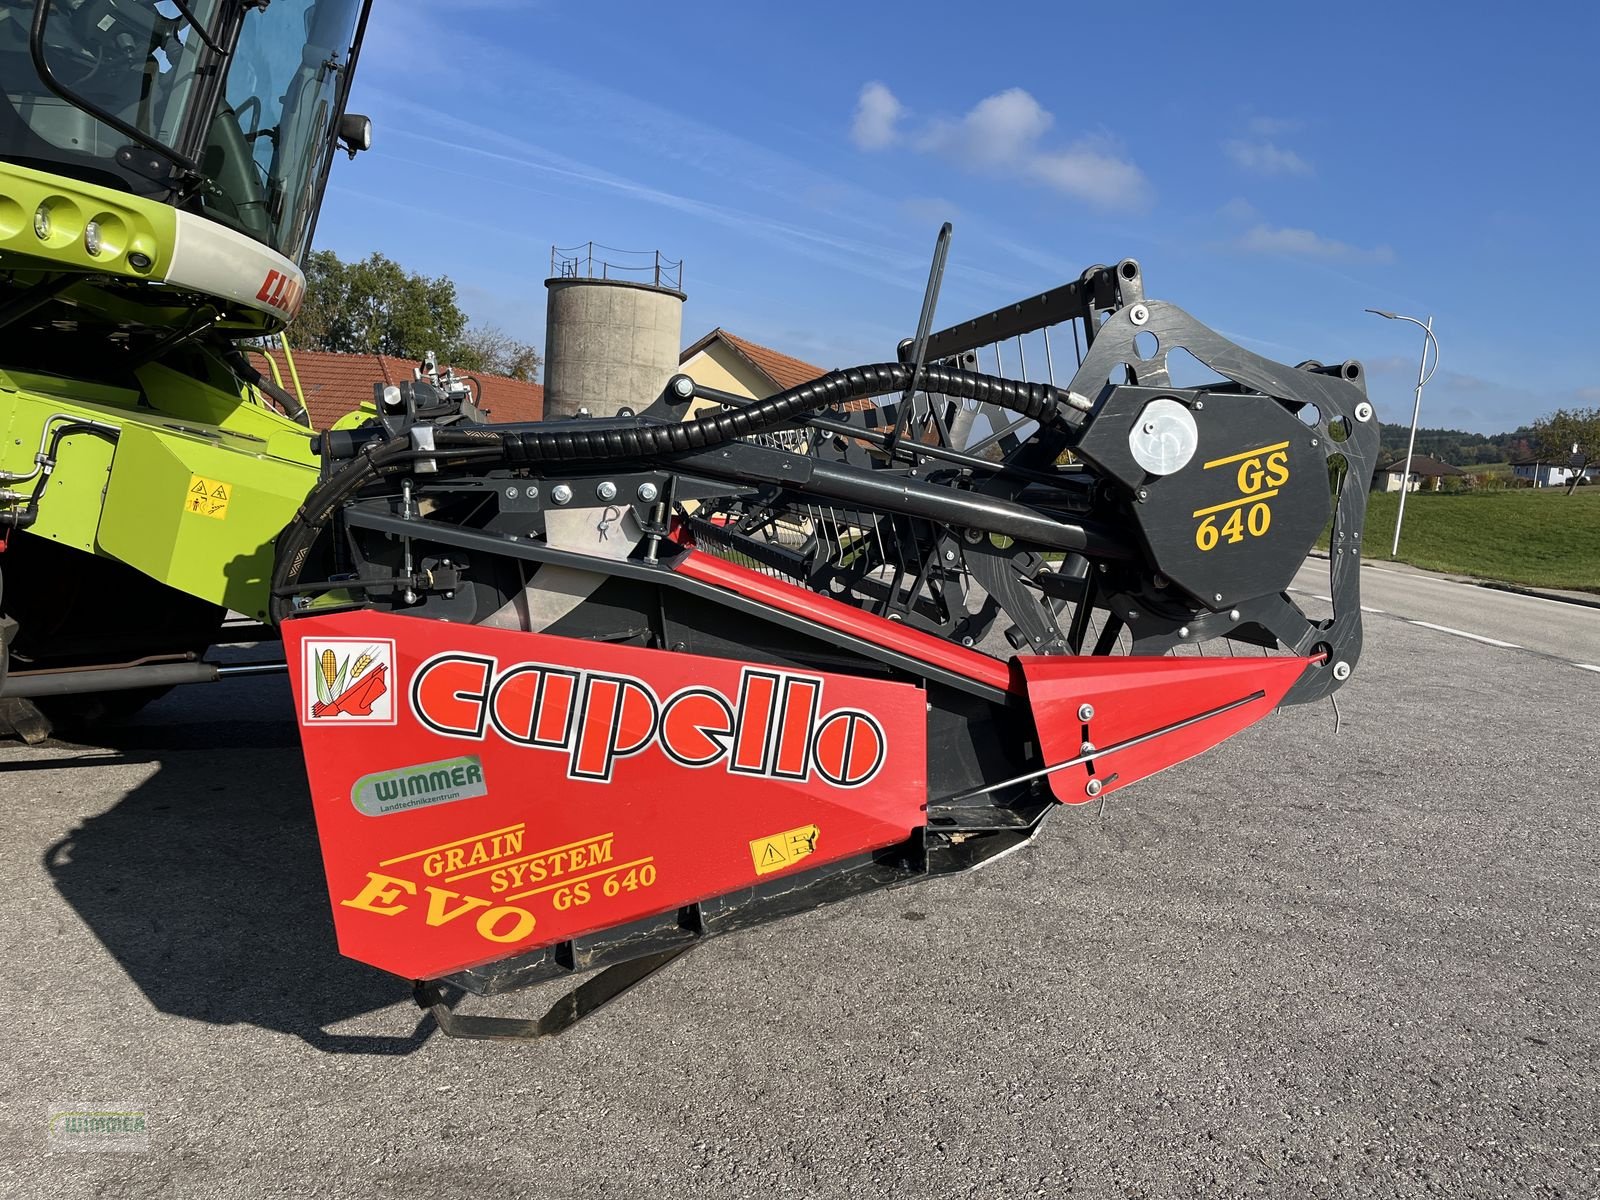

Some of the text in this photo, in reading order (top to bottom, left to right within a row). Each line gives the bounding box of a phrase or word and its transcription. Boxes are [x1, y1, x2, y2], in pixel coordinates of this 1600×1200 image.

[1237, 451, 1290, 494] GS
[1195, 502, 1272, 552] 640
[410, 651, 886, 787] capello
[374, 764, 483, 801] WIMMER
[380, 791, 460, 813] Landtechnikzentrum
[422, 830, 525, 877] GRAIN
[490, 838, 614, 893] SYSTEM
[340, 871, 537, 943] EVO
[551, 864, 657, 911] GS 640
